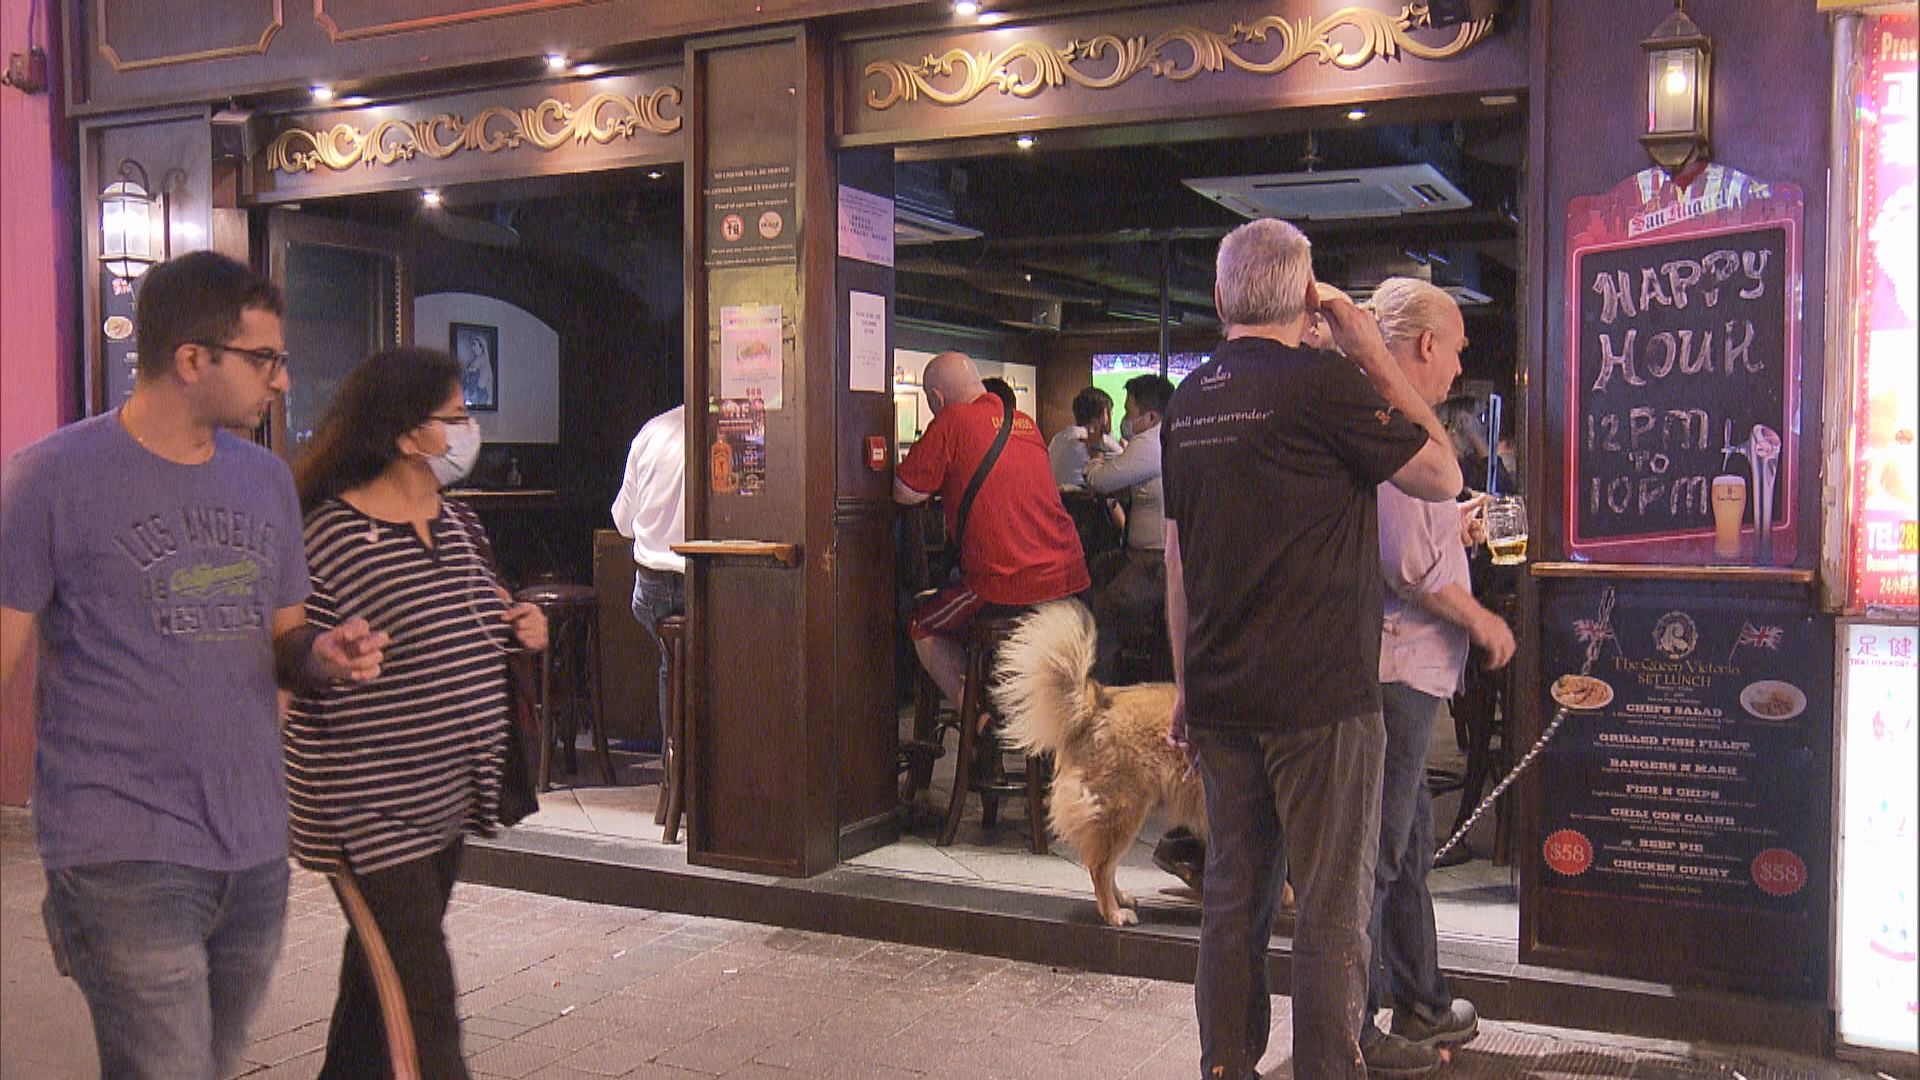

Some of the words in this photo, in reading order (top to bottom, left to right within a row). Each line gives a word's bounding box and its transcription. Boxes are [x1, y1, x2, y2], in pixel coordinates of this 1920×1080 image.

[1631, 211, 1665, 232] San
[1592, 249, 1772, 324] HAPPY
[1592, 319, 1765, 392] HOUR
[1193, 415, 1216, 426] never
[112, 514, 177, 571] LOS
[178, 504, 274, 566] ANGELE
[1611, 656, 1639, 672] The
[1664, 674, 1712, 688] LUNCH
[1674, 706, 1722, 718] SALAD
[1599, 733, 1658, 745] GRILLED
[1662, 737, 1696, 748] FISH
[1699, 740, 1751, 751] FILLET
[1610, 758, 1677, 771] BANGERS
[1695, 765, 1738, 776] MASH
[1625, 784, 1658, 795] FISH
[1676, 788, 1720, 799] CHIPS
[1610, 808, 1649, 819] CHILI
[1652, 811, 1681, 822] CON
[1684, 813, 1735, 826] CARNE
[1550, 843, 1585, 862] $58
[1639, 838, 1676, 850] BEEF
[1679, 842, 1704, 853] PIE
[1613, 859, 1676, 873] CHICKEN
[1679, 865, 1730, 878] CURRY
[1760, 862, 1799, 882] $58
